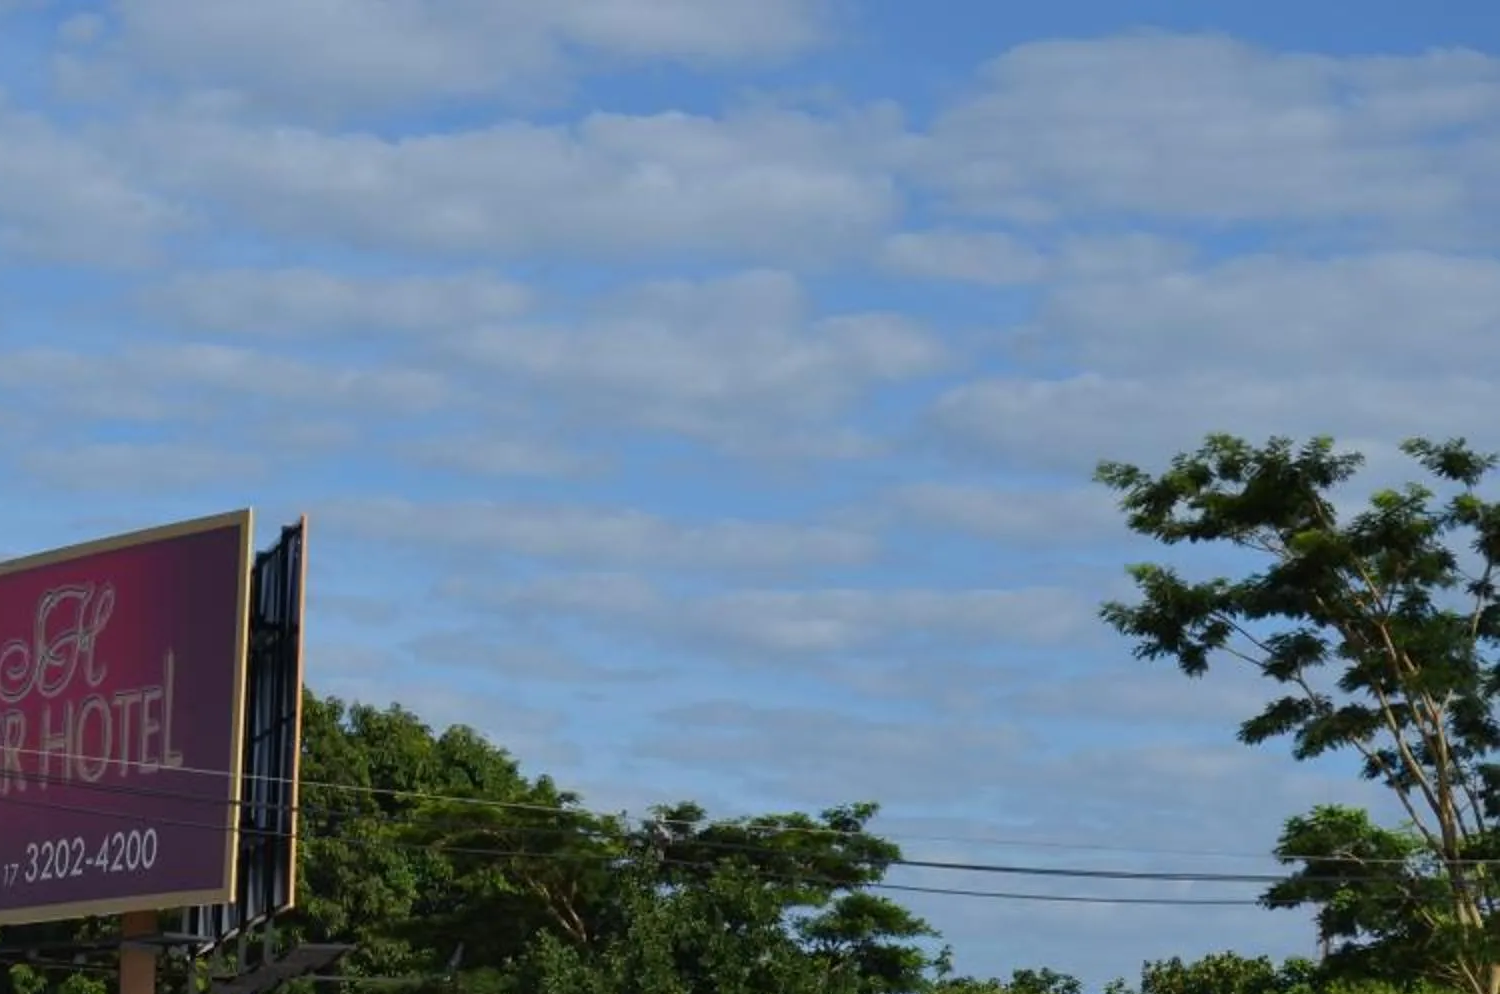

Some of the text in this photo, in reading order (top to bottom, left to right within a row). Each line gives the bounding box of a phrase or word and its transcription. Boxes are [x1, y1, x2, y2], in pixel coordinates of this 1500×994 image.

[38, 649, 184, 791] HOTEL
[3, 862, 19, 888] 17
[24, 827, 158, 884] 3202-4200
